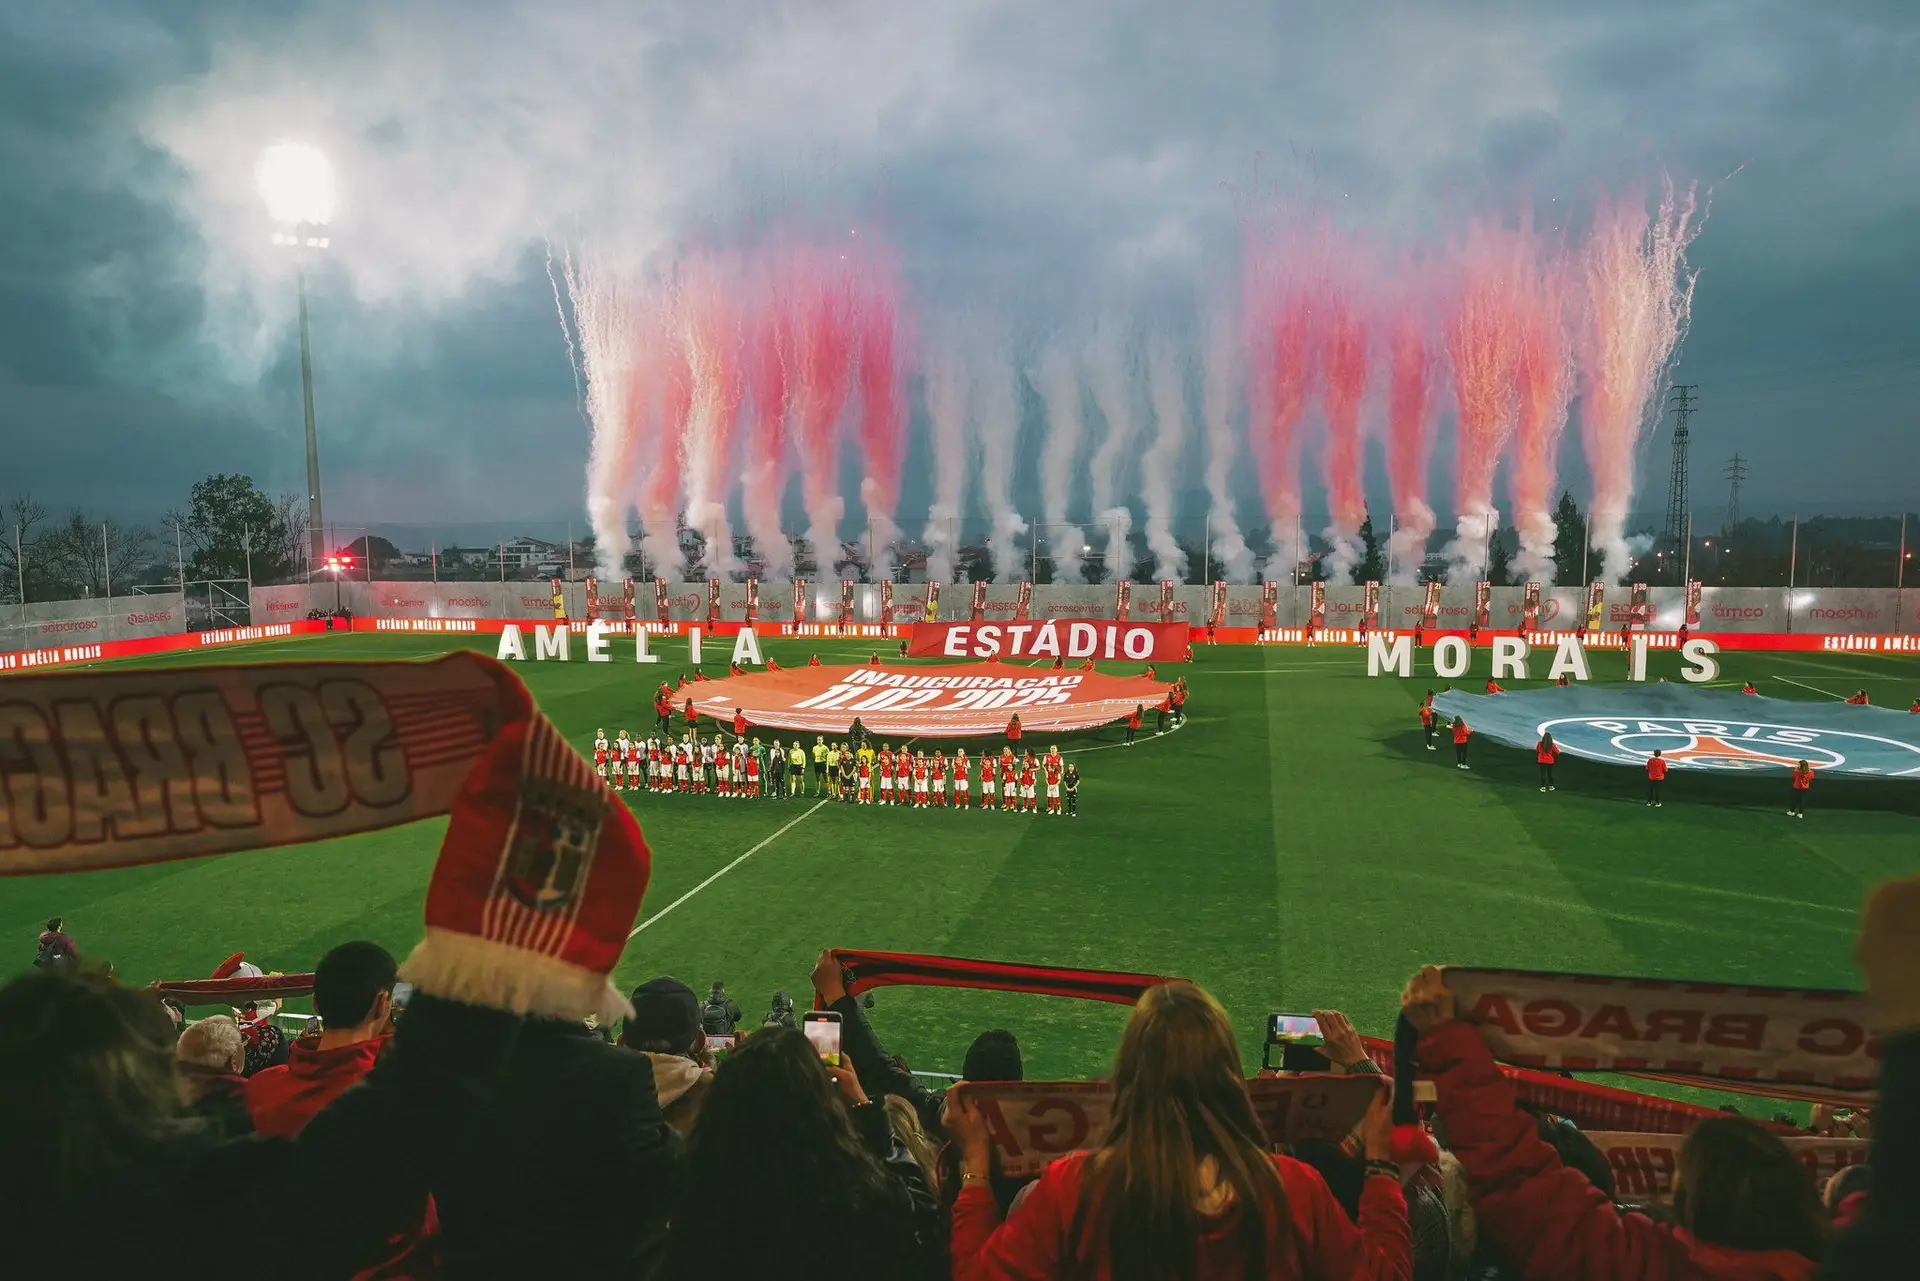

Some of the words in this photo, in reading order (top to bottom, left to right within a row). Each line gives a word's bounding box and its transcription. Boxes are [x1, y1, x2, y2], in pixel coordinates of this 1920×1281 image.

[1370, 580, 1379, 588] 20
[1434, 582, 1441, 590] 21
[1482, 581, 1490, 589] 22
[1595, 582, 1604, 590] 28
[1692, 581, 1702, 589] 37
[1047, 603, 1104, 613] acrescentar
[137, 612, 172, 623] SABSEG
[376, 617, 409, 630] ESTÁDIO
[412, 619, 442, 631] AMÉLIA
[445, 620, 476, 631] MORAIS
[201, 629, 233, 644] ESTÁDIO
[236, 625, 263, 641] AMÉLIA
[265, 623, 292, 637] MORAIS
[782, 623, 819, 635] ESÁDIO
[862, 625, 897, 637] MORIS
[496, 619, 765, 665] AMÉLIA
[943, 618, 1155, 660] ESTÁDIO
[1824, 635, 1877, 650] ESTÁDIO
[22, 650, 60, 667] AMÉLIA
[64, 645, 102, 661] MORAIS
[1367, 635, 1719, 683] MORAIS
[842, 669, 1083, 689] INAUGURAÇÃO
[791, 683, 1072, 713] 11.02.2025
[1586, 719, 1822, 743] PARIS
